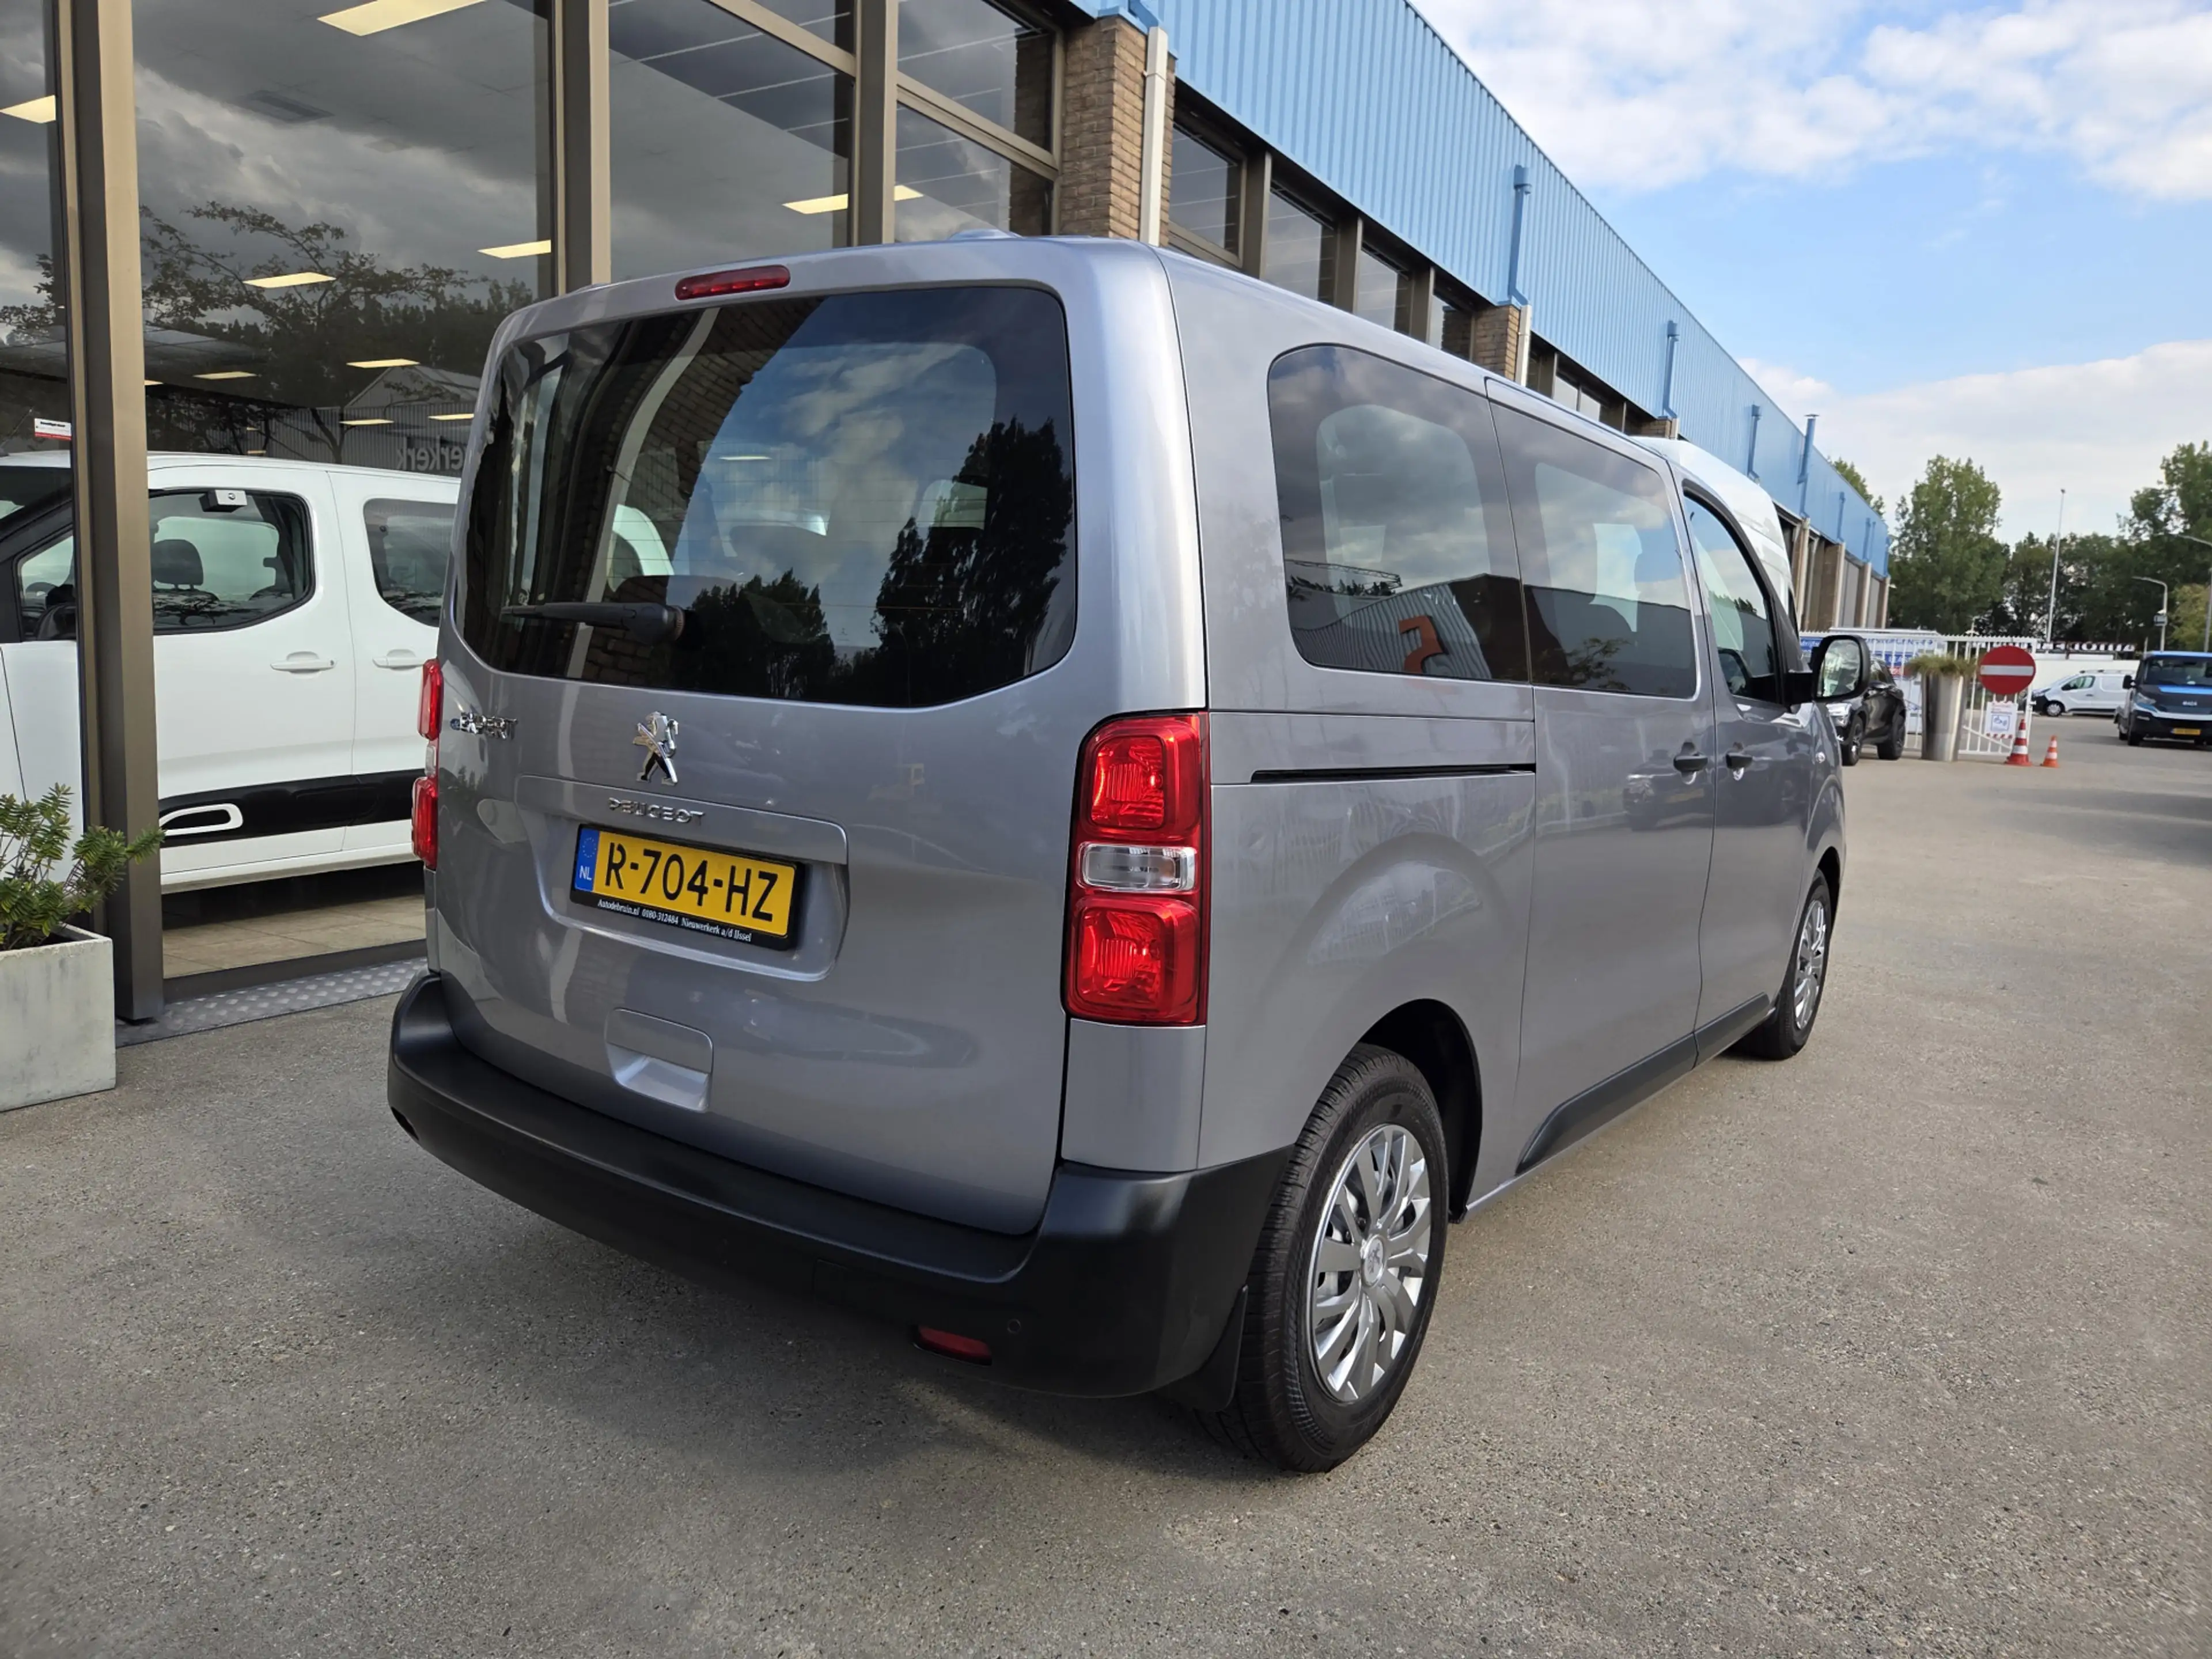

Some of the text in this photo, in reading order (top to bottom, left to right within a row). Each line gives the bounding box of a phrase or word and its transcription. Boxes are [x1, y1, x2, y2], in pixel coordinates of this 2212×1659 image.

[607, 797, 705, 825] PEUGEOT
[579, 842, 778, 922] NL R-704-HZ
[597, 899, 640, 915] Autodebruin.nl
[642, 908, 679, 925] 0180-312484
[681, 917, 720, 934] Nieuwerkerk
[721, 927, 733, 938] a/d
